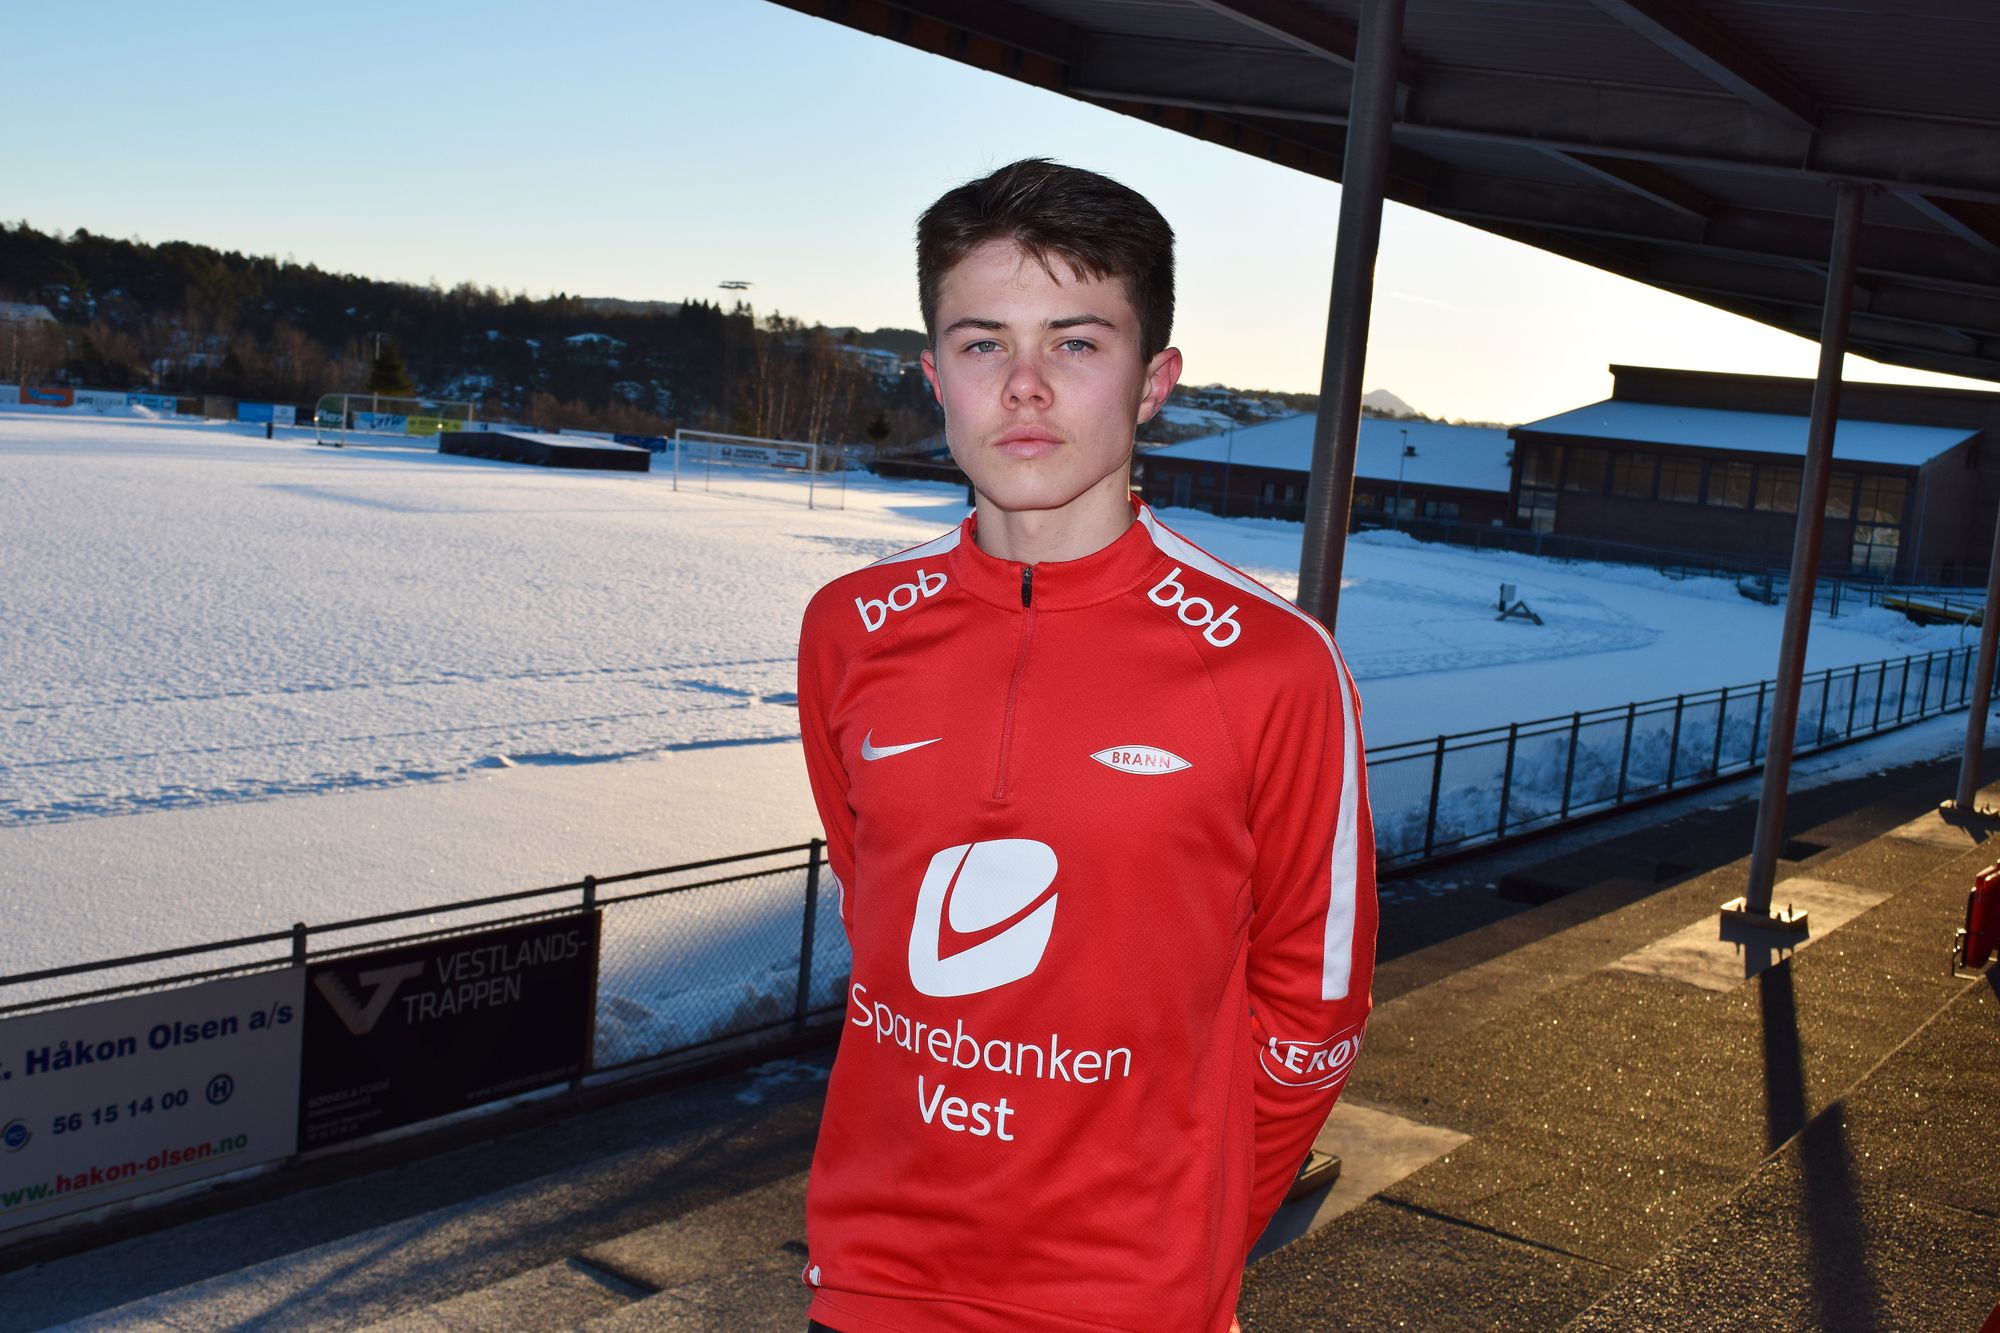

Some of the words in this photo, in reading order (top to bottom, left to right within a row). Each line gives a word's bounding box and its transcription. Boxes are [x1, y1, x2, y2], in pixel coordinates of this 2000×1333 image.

[855, 569, 948, 632] bob
[1147, 567, 1241, 647] bob
[1111, 751, 1171, 769] BRANN
[436, 930, 588, 984] VESTLANDS-
[402, 974, 522, 1024] TRAPPEN
[25, 1040, 137, 1076] Håkon
[148, 1016, 238, 1050] Olsen
[249, 1001, 293, 1030] a/s
[851, 982, 1132, 1084] Sparebanken
[53, 1112, 82, 1135] 56
[92, 1105, 119, 1126] 15
[128, 1097, 154, 1118] 14
[161, 1088, 189, 1110] 00
[918, 1074, 1014, 1141] Vest
[0, 1132, 248, 1208] ww.hakon-olsen.no
